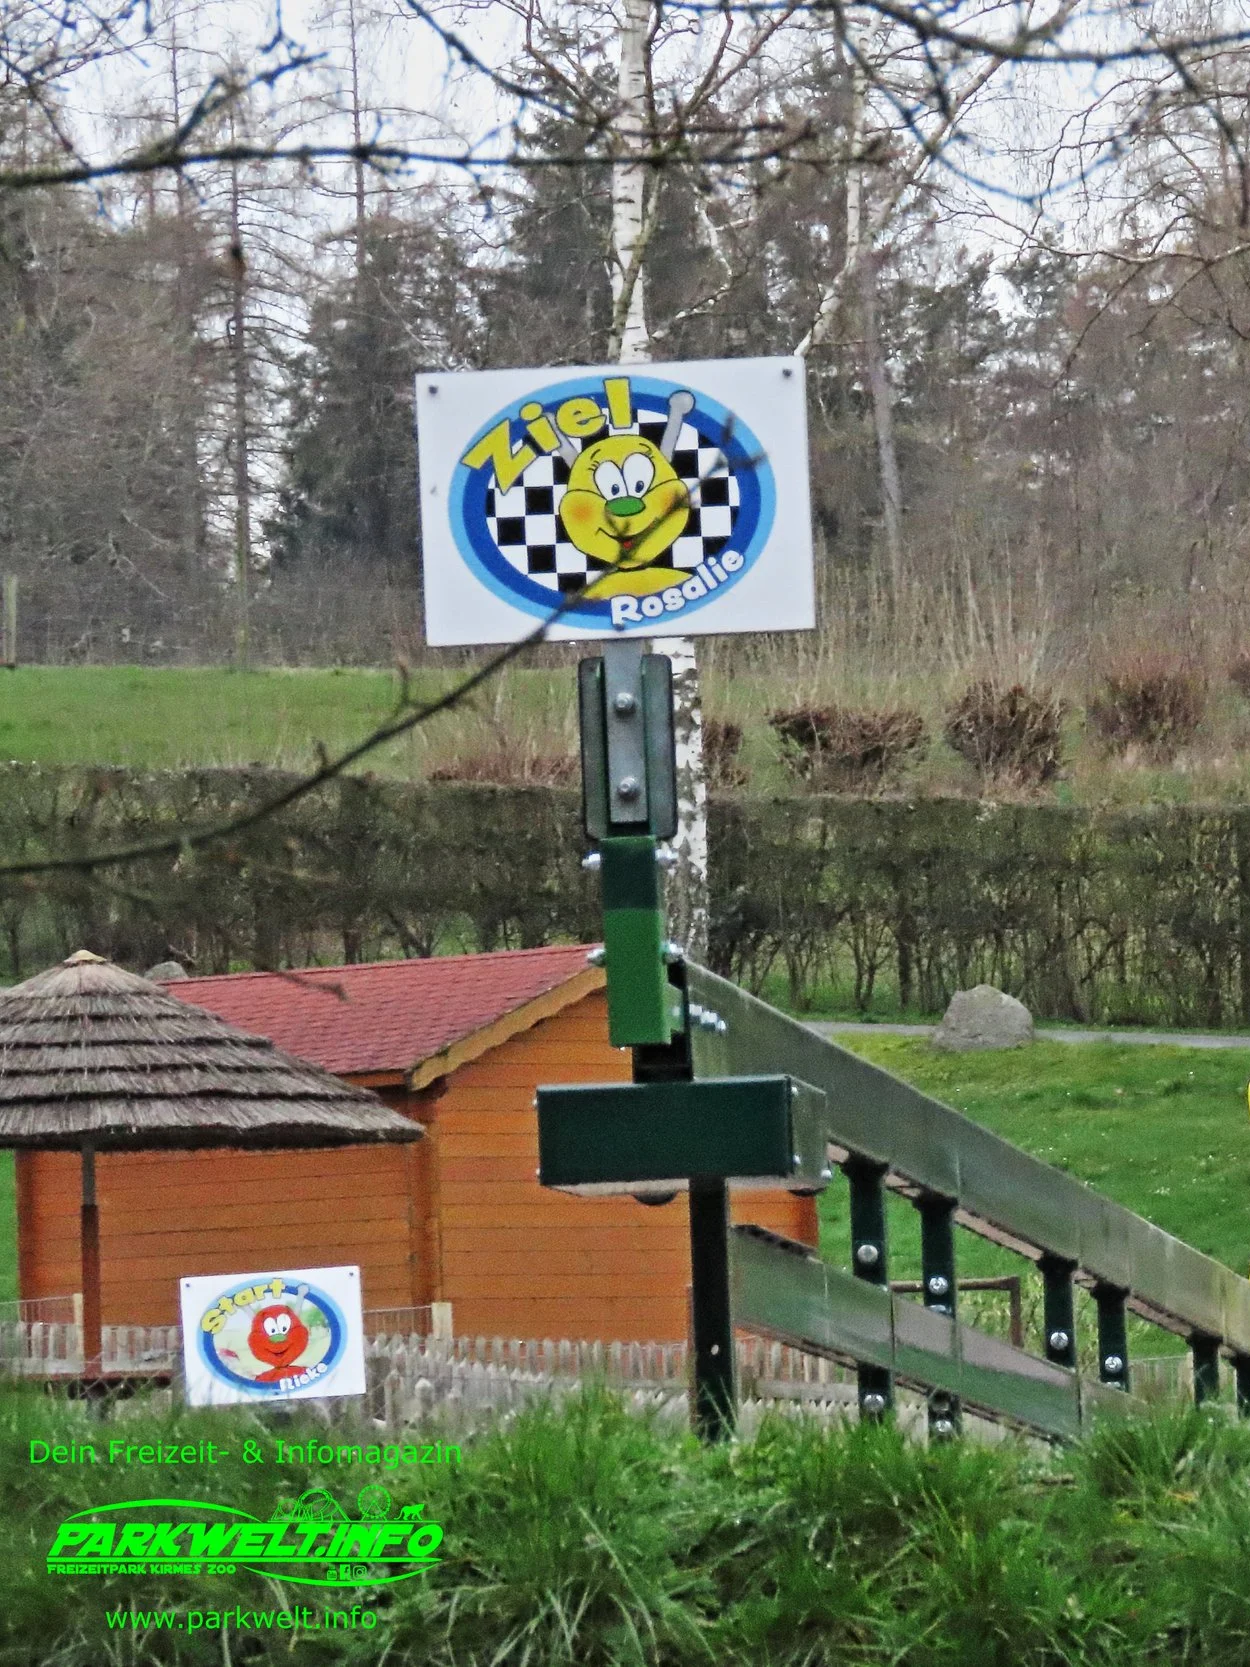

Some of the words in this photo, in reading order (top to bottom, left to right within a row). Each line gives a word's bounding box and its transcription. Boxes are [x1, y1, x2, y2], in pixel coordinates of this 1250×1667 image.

[461, 376, 633, 495] Ziel
[610, 549, 745, 626] Rosalie
[202, 1278, 285, 1334] Start
